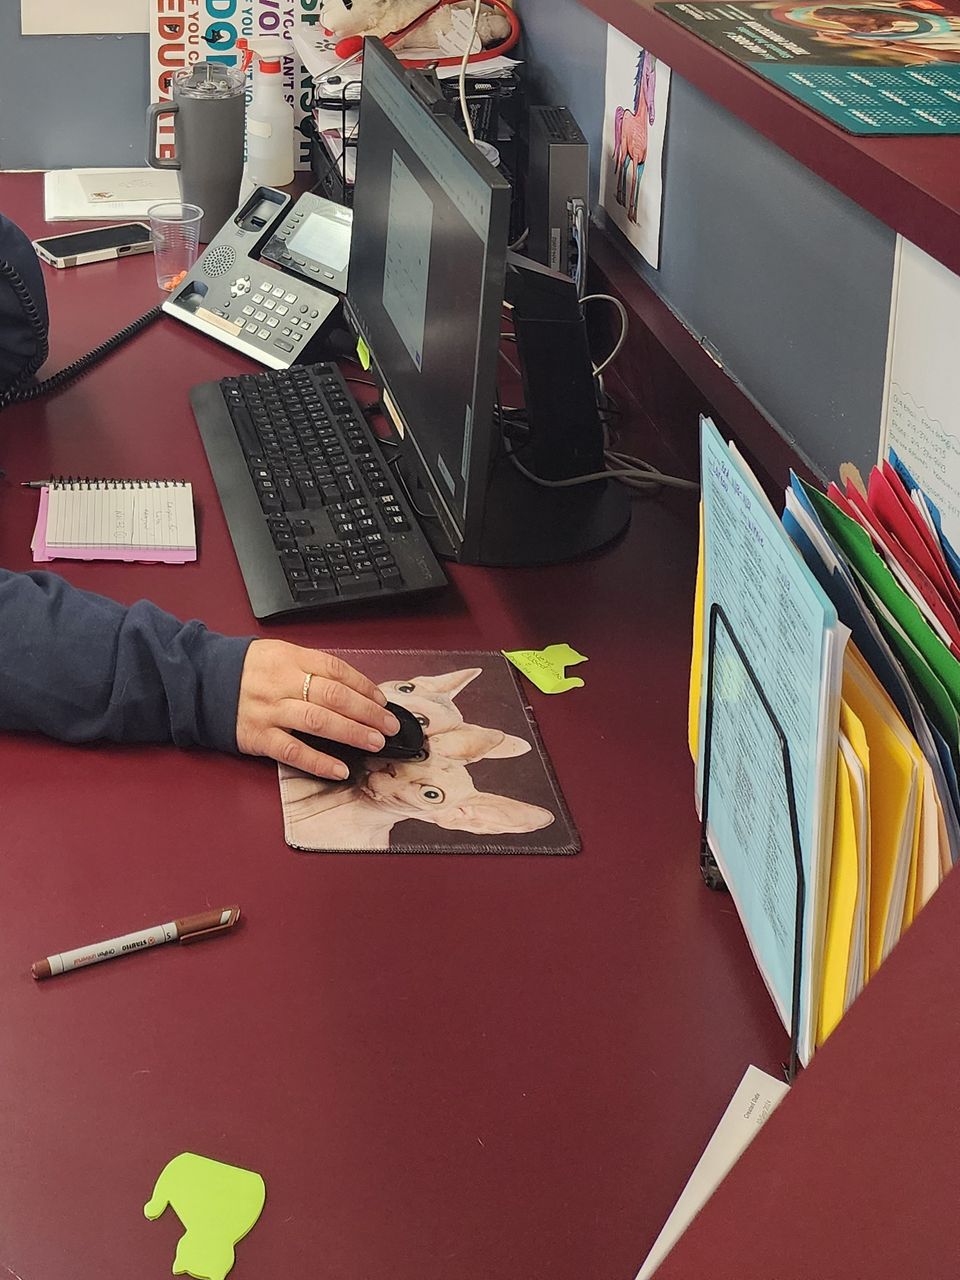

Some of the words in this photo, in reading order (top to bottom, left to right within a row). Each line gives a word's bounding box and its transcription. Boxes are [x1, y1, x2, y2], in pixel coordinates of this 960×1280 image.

[188, 11, 199, 44] YOU
[241, 7, 253, 35] YOU
[283, 55, 294, 90] AN'T
[121, 939, 148, 952] STABILO
